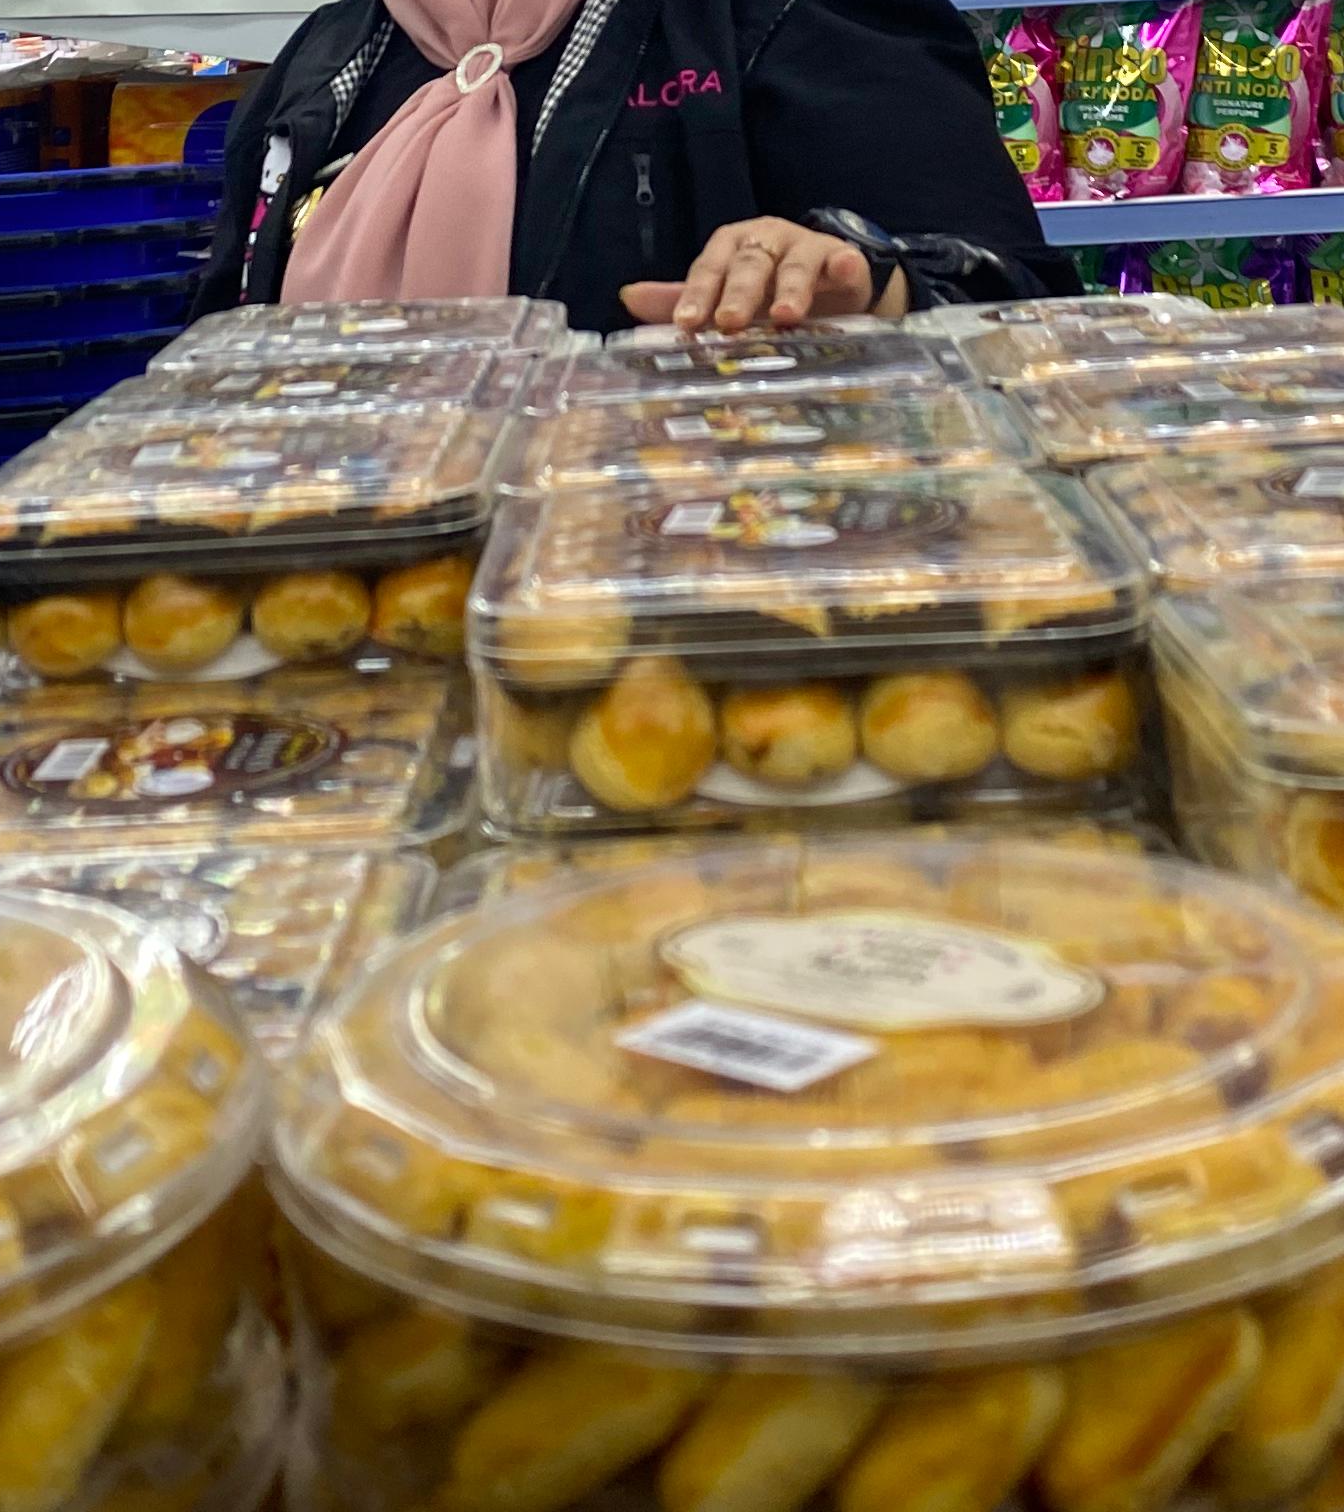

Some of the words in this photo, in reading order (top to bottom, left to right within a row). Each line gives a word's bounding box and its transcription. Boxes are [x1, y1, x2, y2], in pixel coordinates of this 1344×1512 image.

[1105, 87, 1158, 102] NODA
[1236, 83, 1290, 99] NODA
[1213, 99, 1264, 110] SIGNATURE
[1215, 108, 1260, 119] PERFUME
[1135, 145, 1145, 159] 5
[1268, 143, 1278, 155] 5
